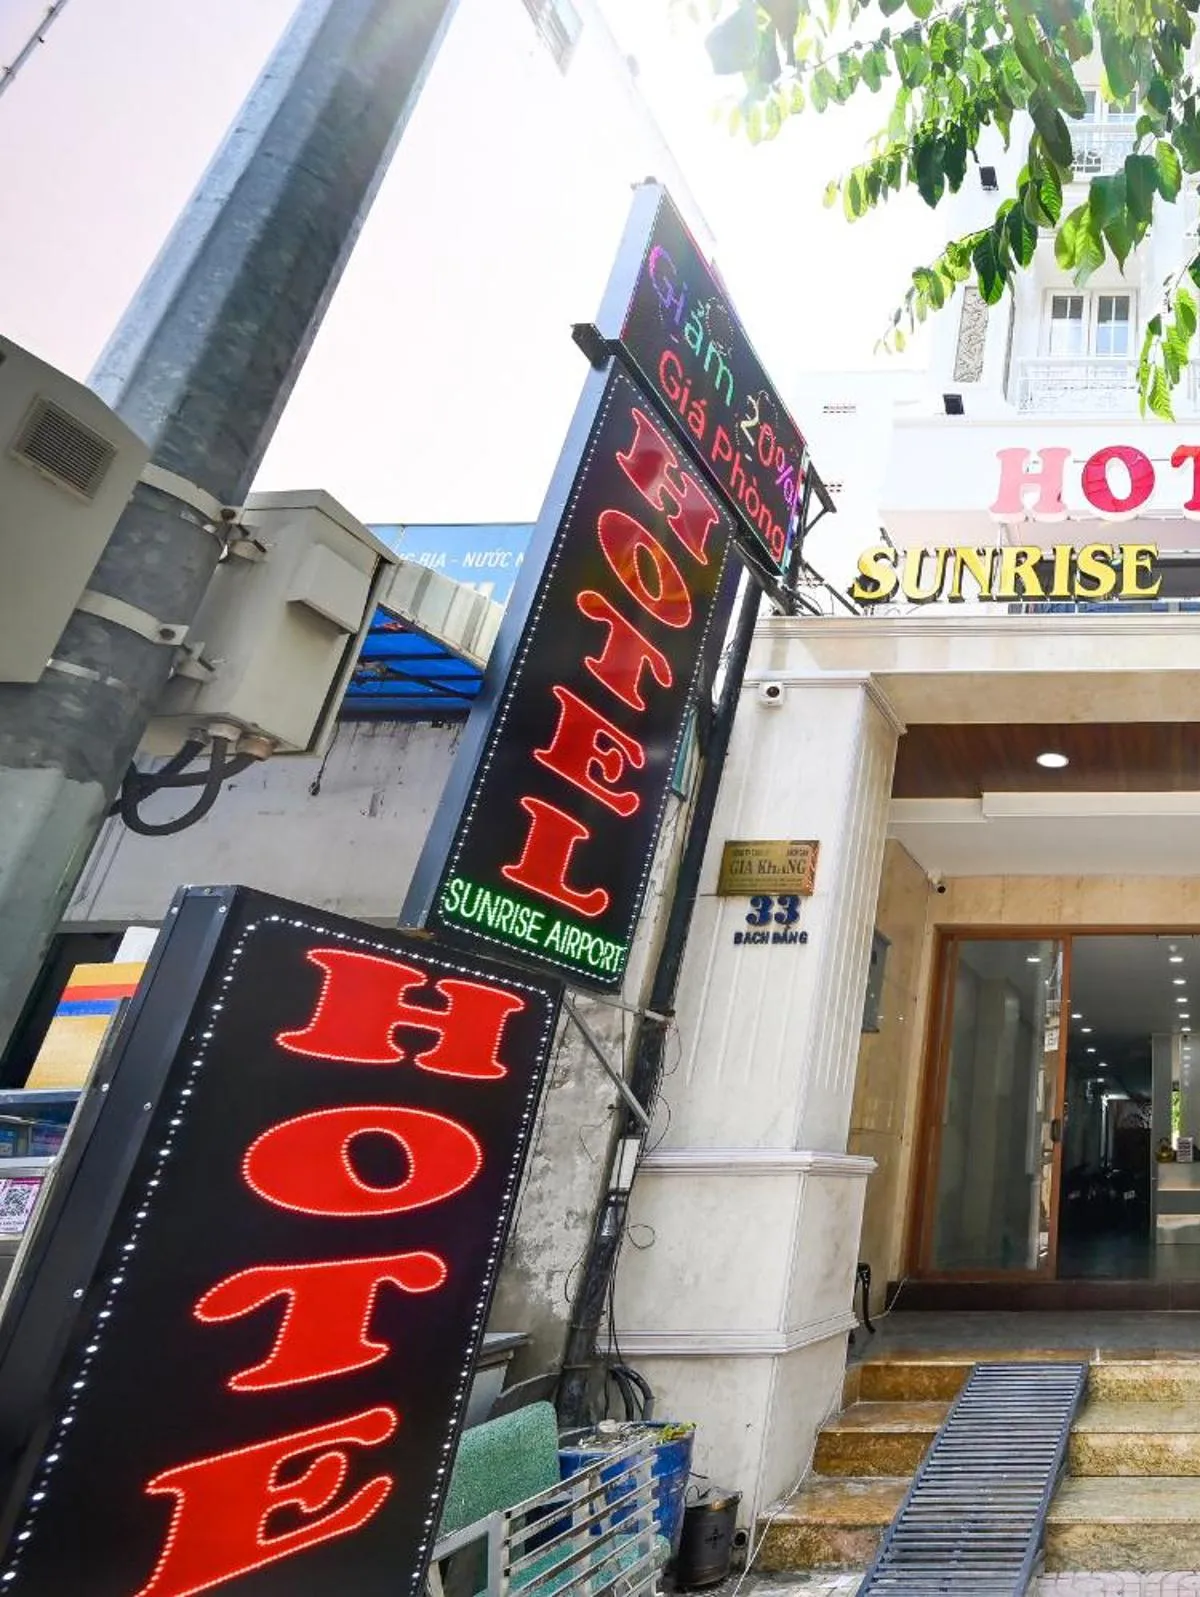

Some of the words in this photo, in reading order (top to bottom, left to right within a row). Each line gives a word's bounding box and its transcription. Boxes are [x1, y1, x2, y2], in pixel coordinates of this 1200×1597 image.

[848, 543, 1162, 604] SUNRISE
[502, 407, 721, 918] HOTEL
[444, 877, 545, 944] SUNRISE
[543, 920, 628, 973] AIRPORT
[745, 896, 801, 927] 33
